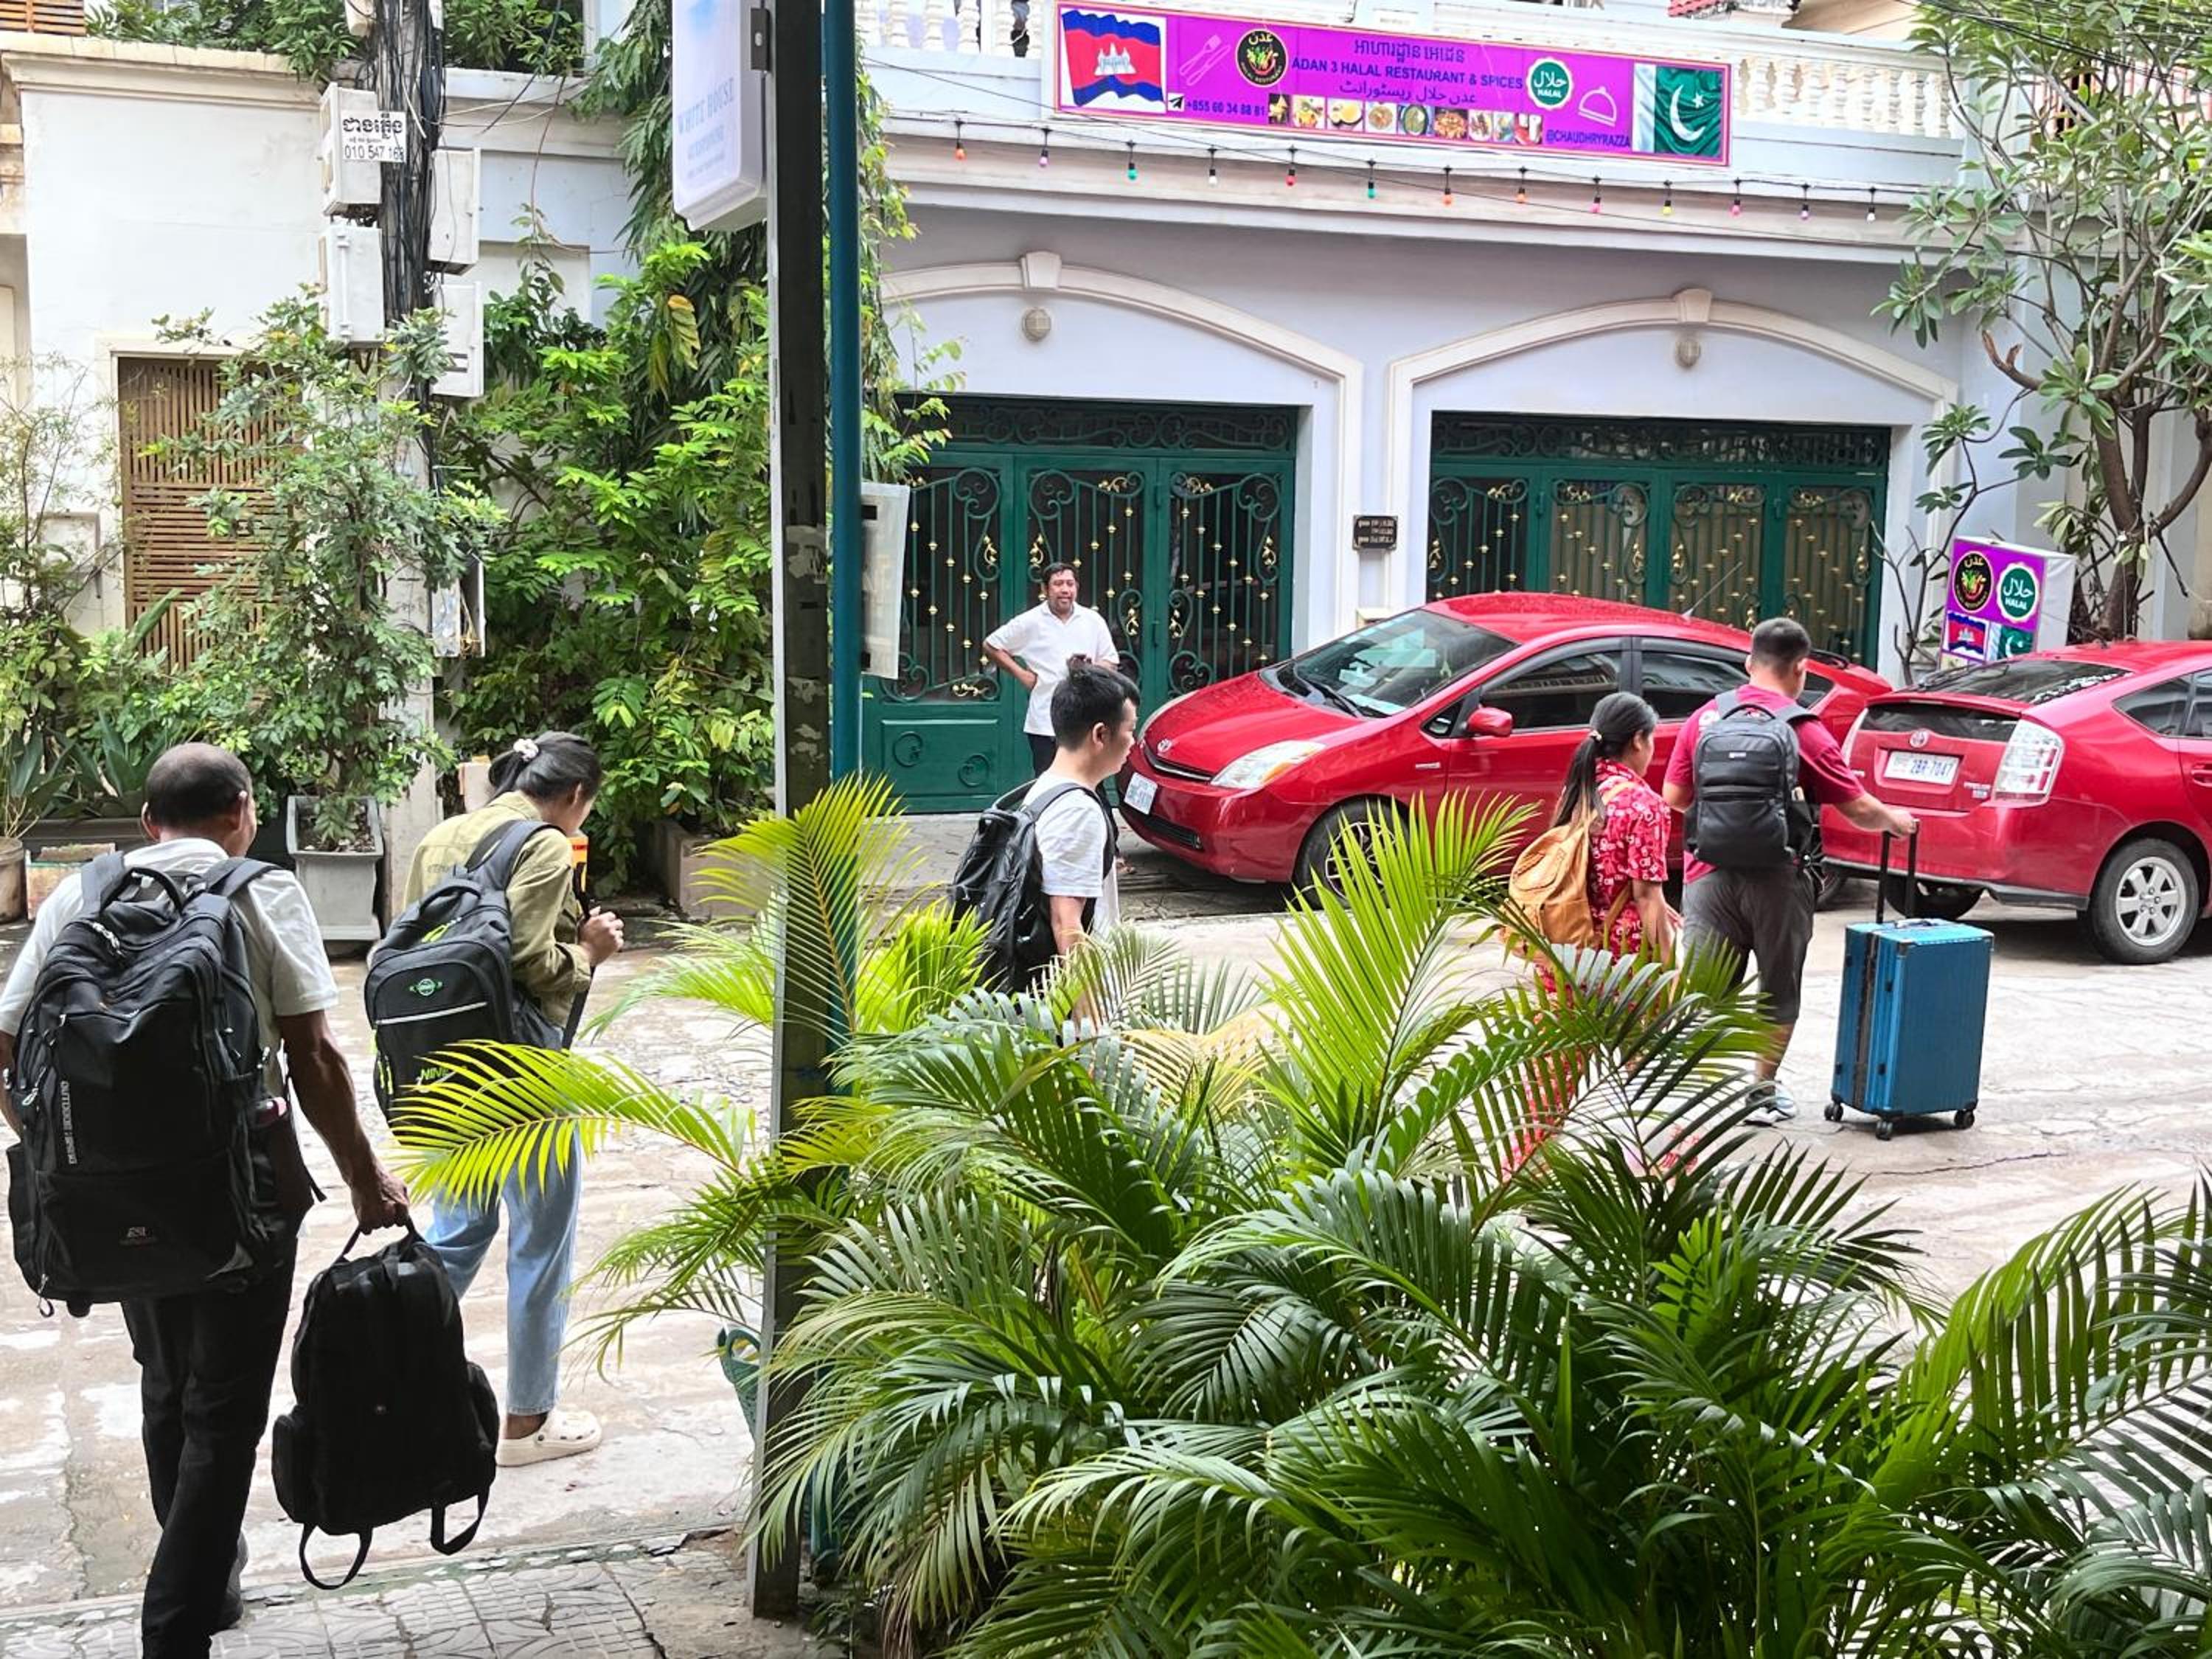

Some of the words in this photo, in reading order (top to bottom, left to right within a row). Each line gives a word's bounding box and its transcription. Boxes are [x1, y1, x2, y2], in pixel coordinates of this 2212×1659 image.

[1292, 58, 1328, 72] ADAN
[1331, 60, 1338, 72] 3
[1341, 61, 1381, 77] HALAL
[1385, 66, 1465, 84] RESTAURANT
[1469, 74, 1477, 86] &
[1481, 74, 1523, 89] SPICES
[1534, 71, 1567, 88] حلال
[1416, 86, 1447, 102] حلال
[1537, 88, 1562, 98] HALAL
[343, 113, 403, 139] ជាងភ្លើង
[344, 144, 365, 159] 010
[368, 145, 385, 160] 547
[2003, 577, 2034, 598] حلال
[2005, 597, 2028, 611] HALAL
